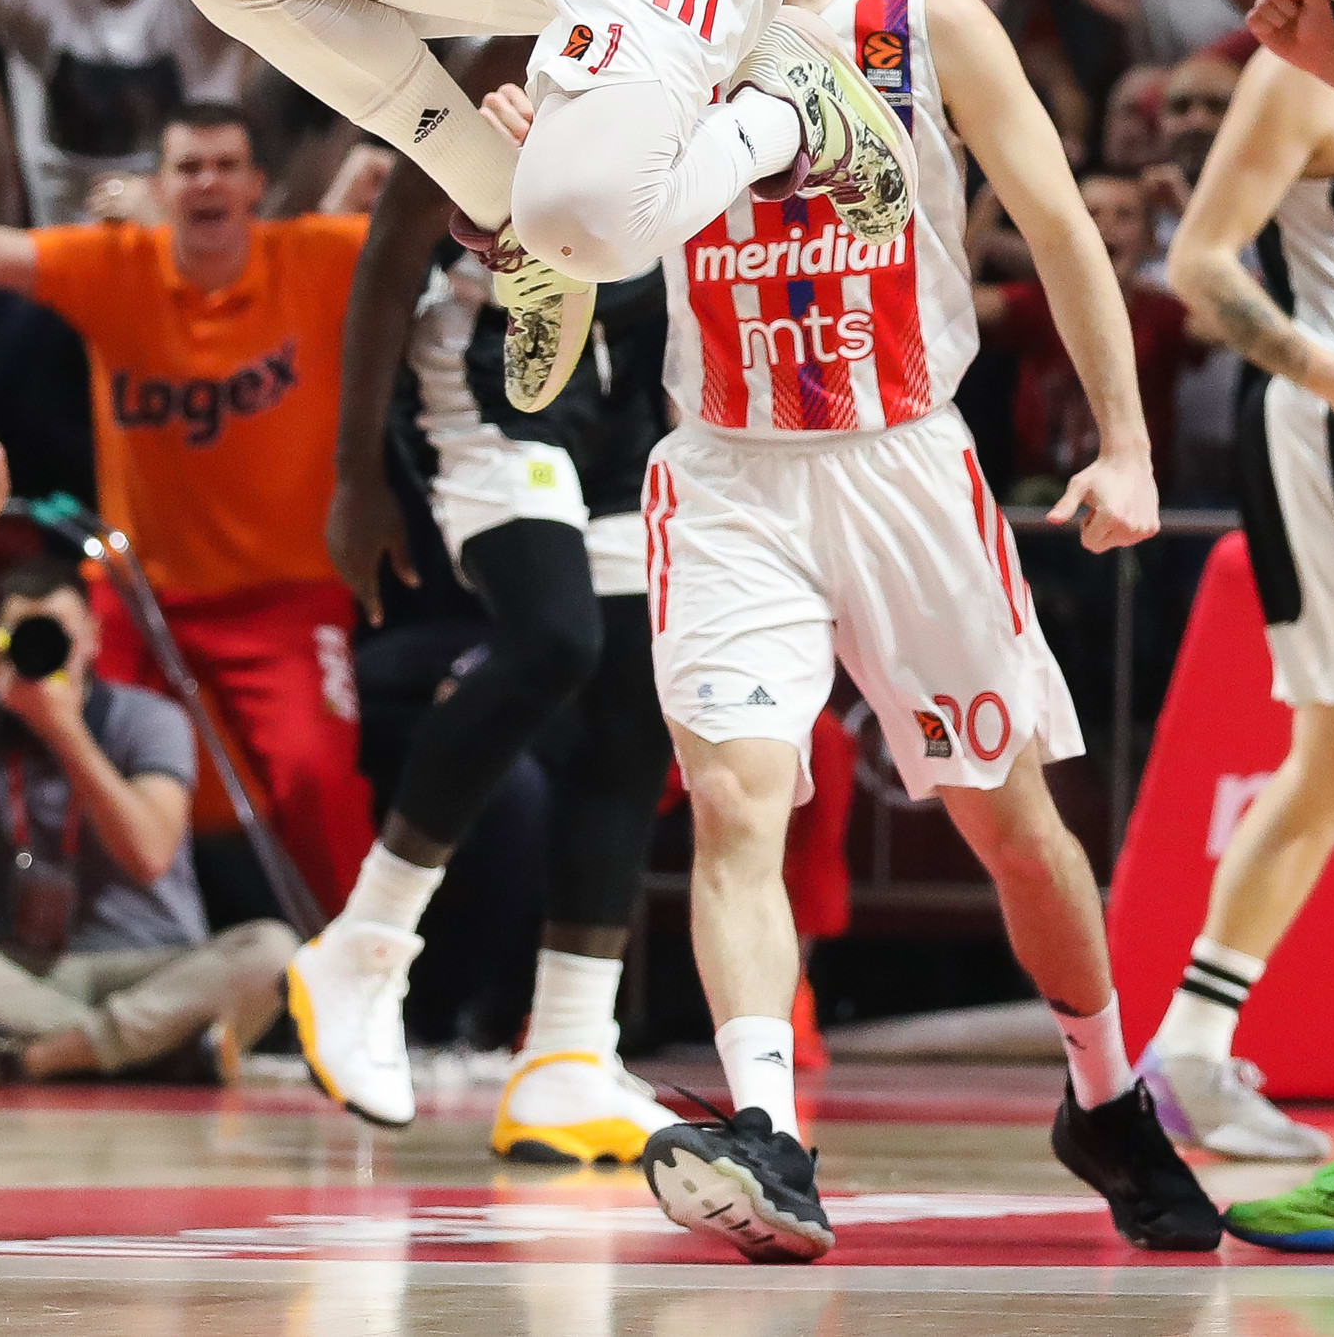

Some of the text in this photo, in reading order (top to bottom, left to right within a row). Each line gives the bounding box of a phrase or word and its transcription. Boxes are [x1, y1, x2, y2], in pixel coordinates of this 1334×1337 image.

[413, 107, 450, 143] adidas
[694, 223, 906, 281] meridian
[738, 305, 875, 367] mts
